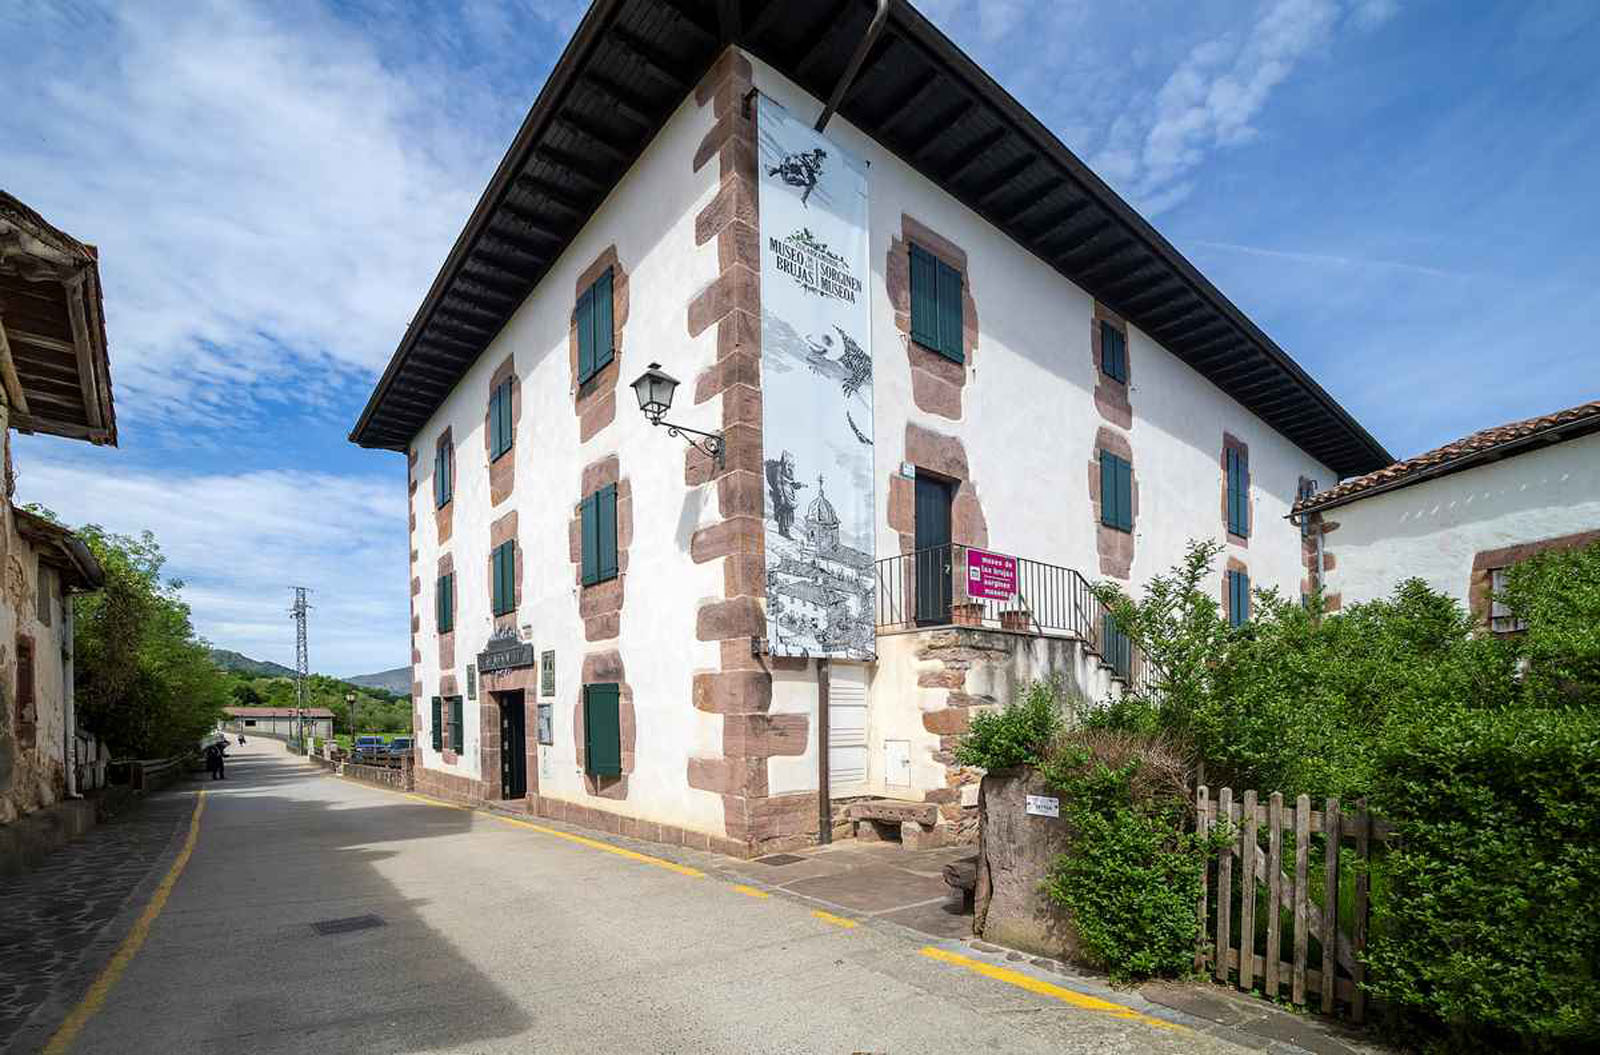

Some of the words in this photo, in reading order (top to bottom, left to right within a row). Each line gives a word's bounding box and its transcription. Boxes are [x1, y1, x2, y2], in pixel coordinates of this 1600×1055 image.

[770, 237, 804, 265] MUSEO
[777, 256, 814, 285] BRUJAS
[820, 263, 862, 292] SORGINEN
[821, 277, 855, 304] MUSEOA
